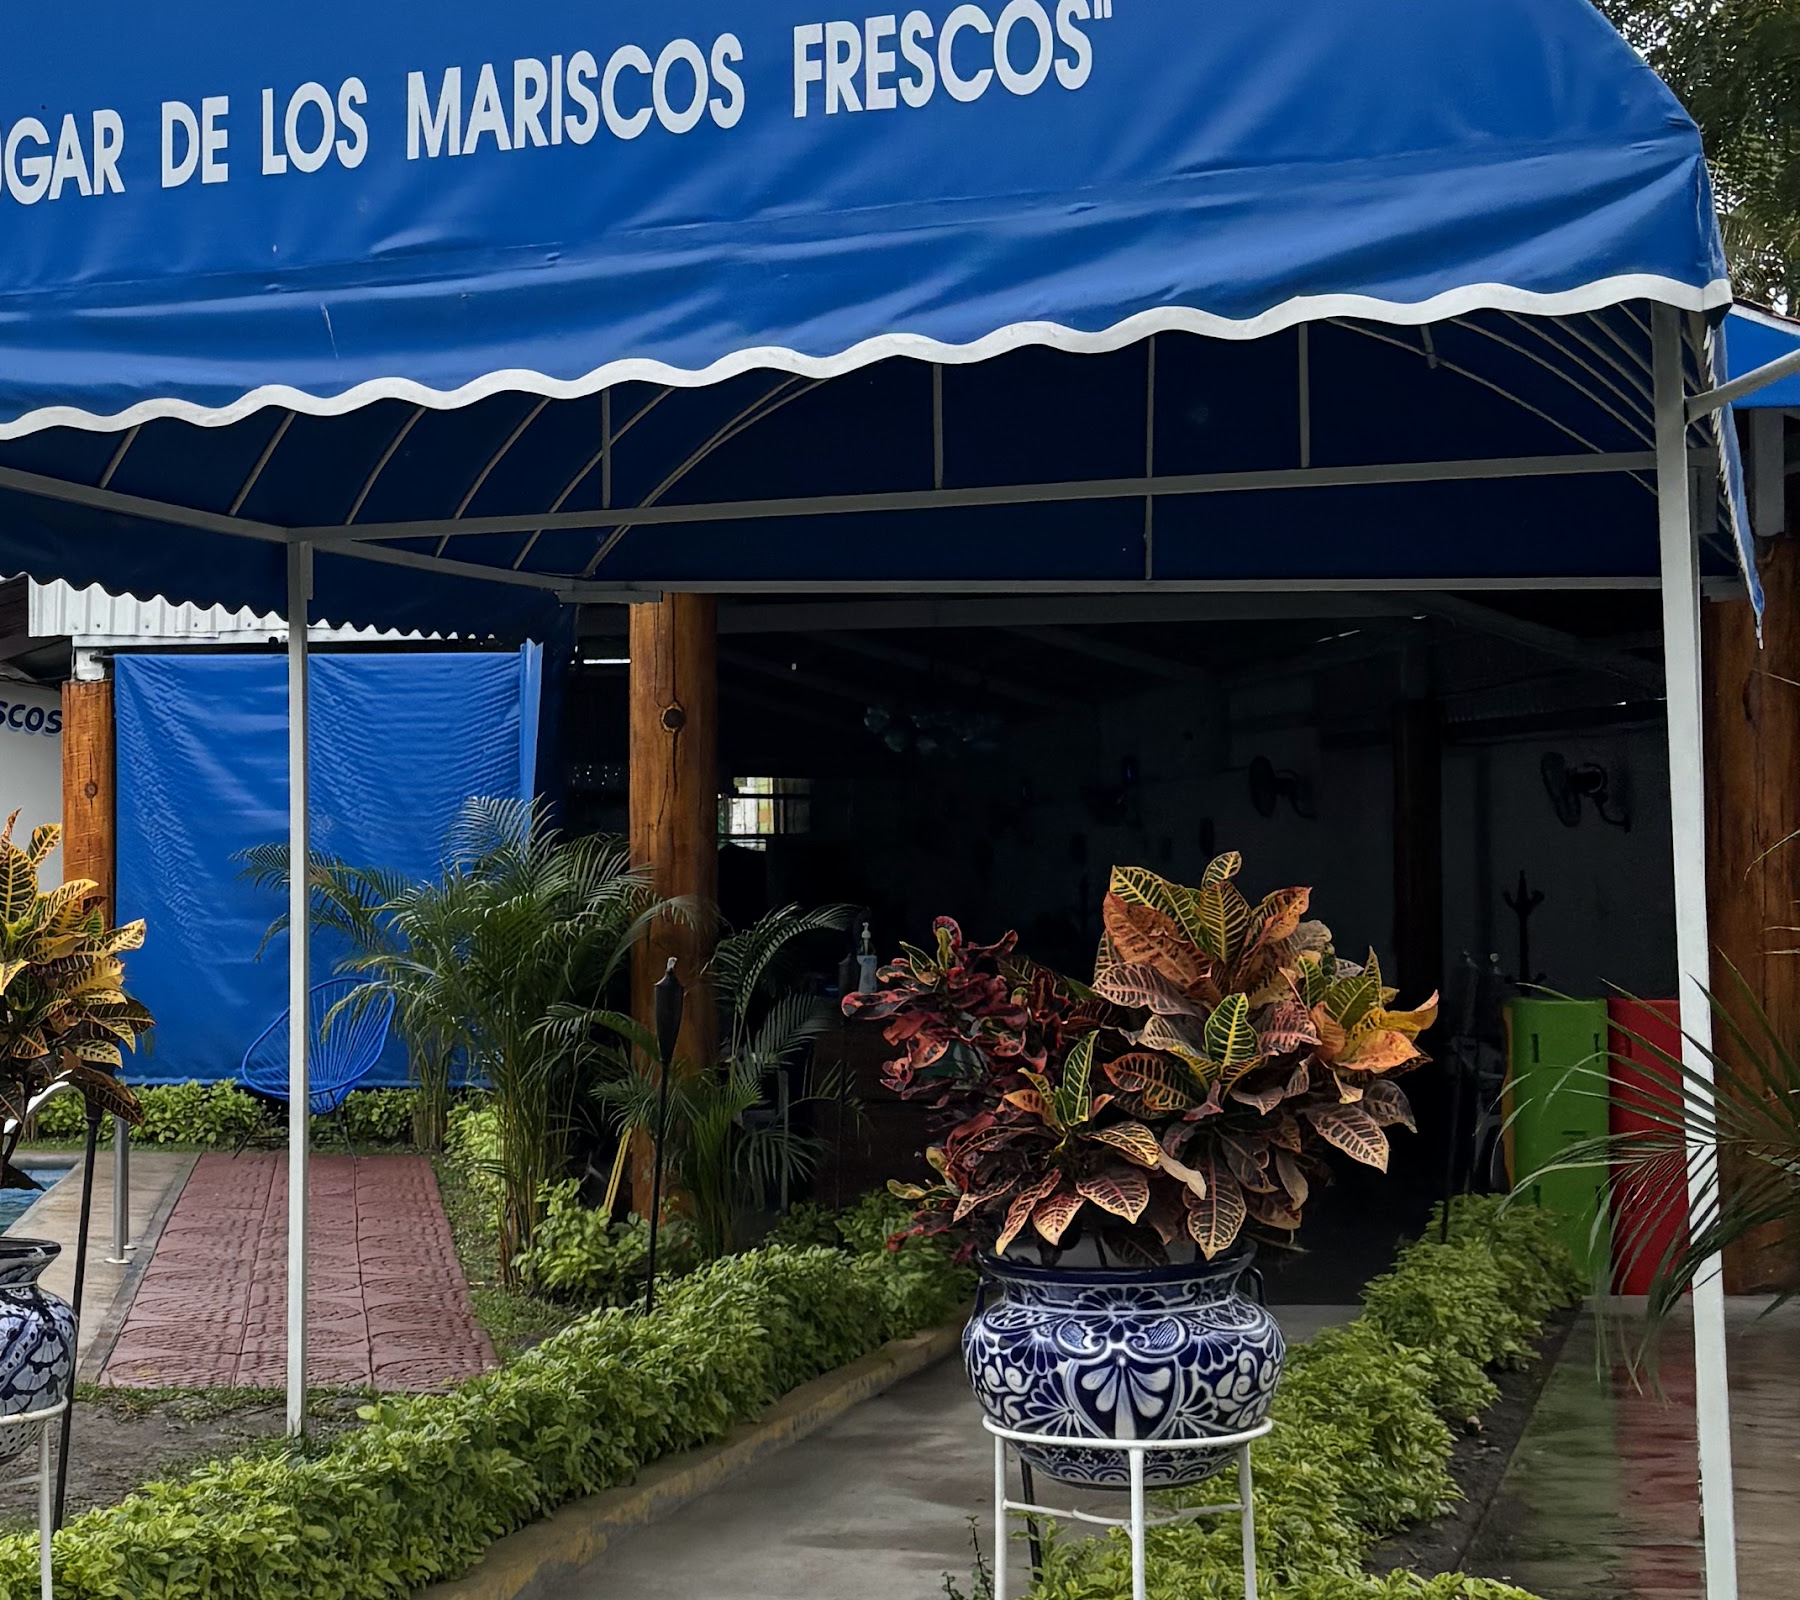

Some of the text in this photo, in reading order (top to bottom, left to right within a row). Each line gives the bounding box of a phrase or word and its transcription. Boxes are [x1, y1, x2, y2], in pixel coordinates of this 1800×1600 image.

[161, 95, 230, 189] DE
[261, 76, 368, 176] LOS
[407, 32, 745, 161] MARISCOS
